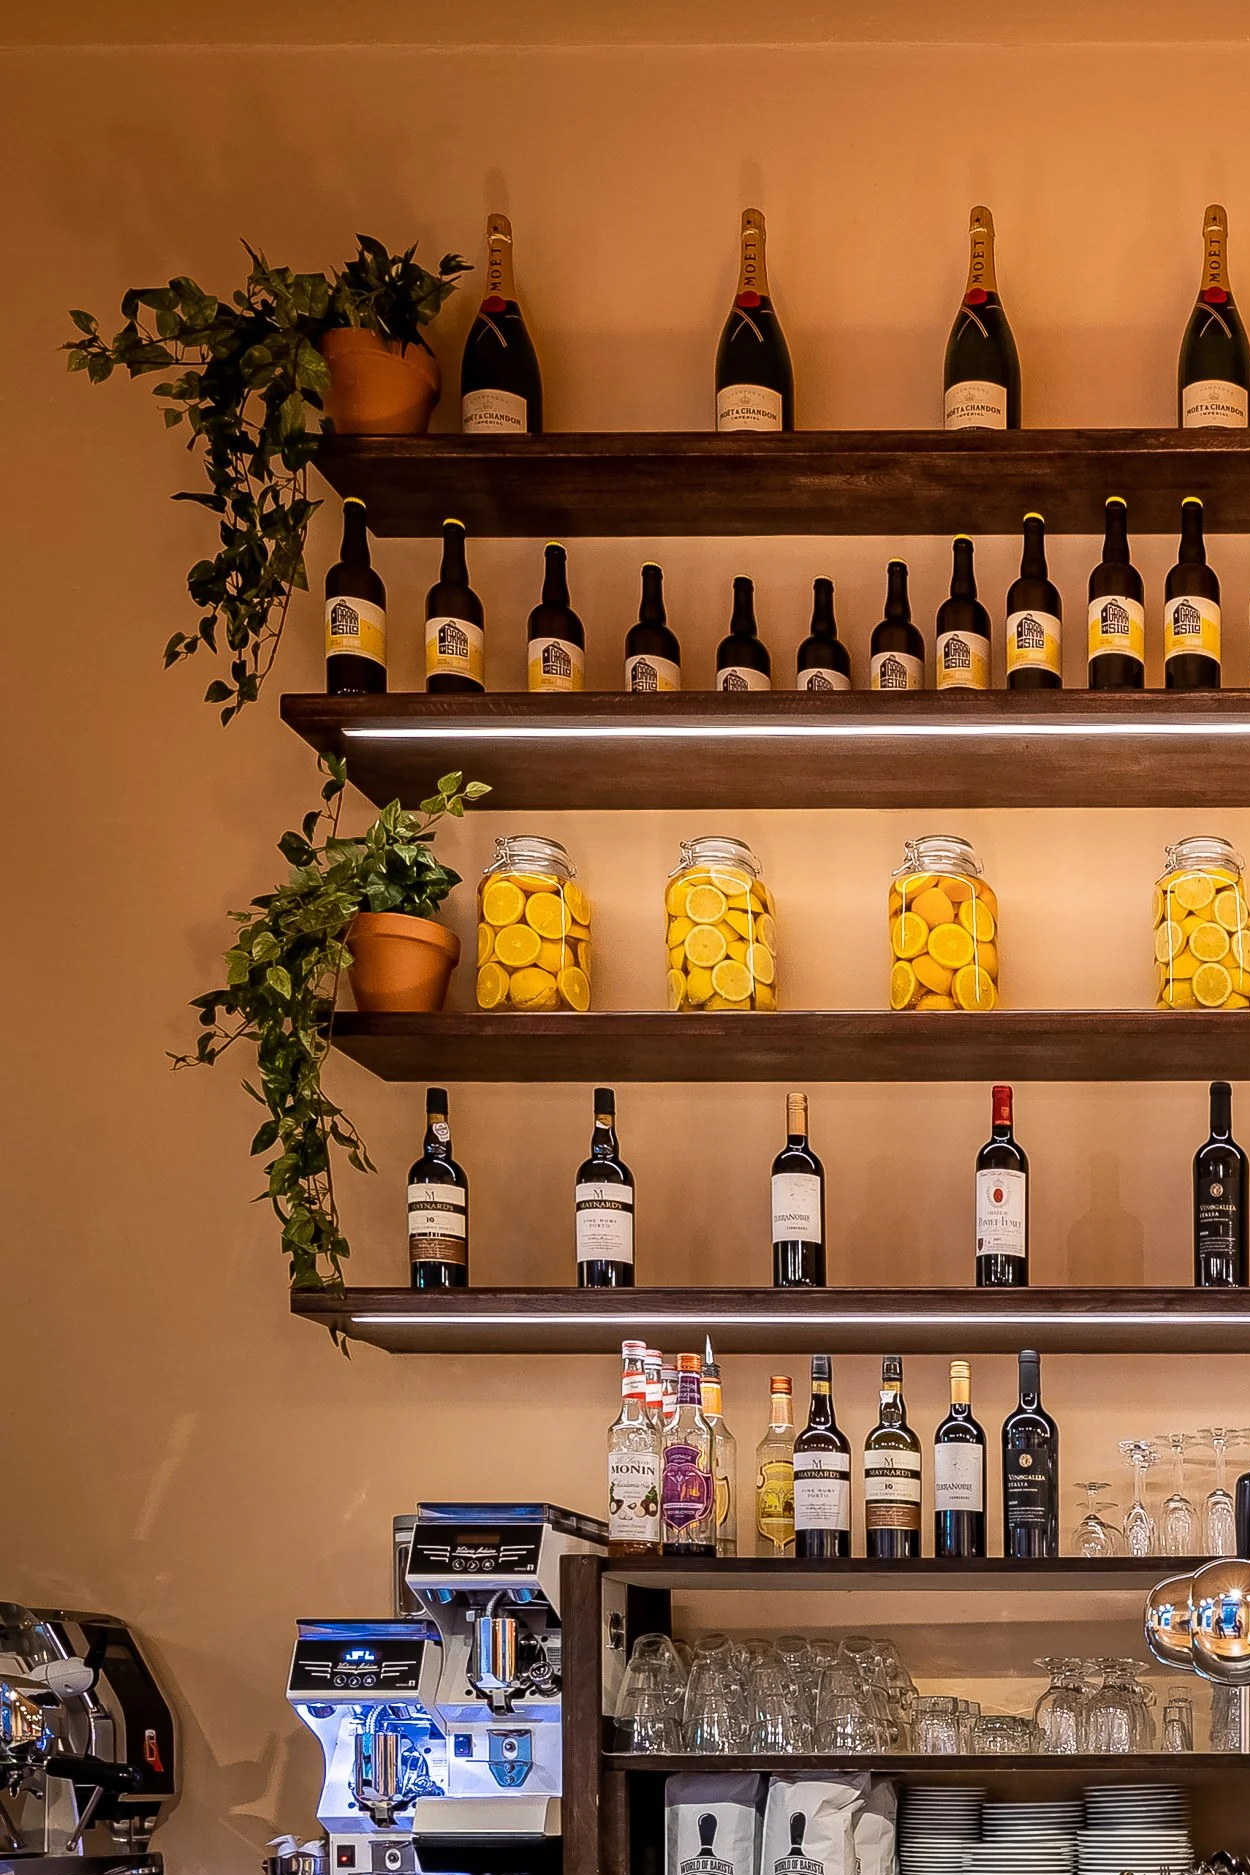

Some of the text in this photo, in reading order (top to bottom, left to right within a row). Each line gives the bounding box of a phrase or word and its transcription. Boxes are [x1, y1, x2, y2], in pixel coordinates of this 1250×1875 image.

[740, 407, 776, 421] CHANDON
[965, 404, 1001, 415] CHANDON
[1210, 403, 1244, 417] CHANDON
[483, 412, 521, 426] CHANDON
[337, 624, 359, 635] SILO
[1108, 624, 1129, 635] SILO
[1180, 623, 1201, 635] SILO
[1023, 638, 1044, 649] SILO
[446, 645, 469, 657] SILO
[950, 658, 970, 668] SILO
[551, 665, 572, 678] SILO
[887, 678, 907, 689] SILO
[611, 1464, 655, 1477] MONIN
[680, 1859, 700, 1875] WORLD
[701, 1859, 709, 1870] OF
[774, 1859, 825, 1875] WORLD OF BARISTA
